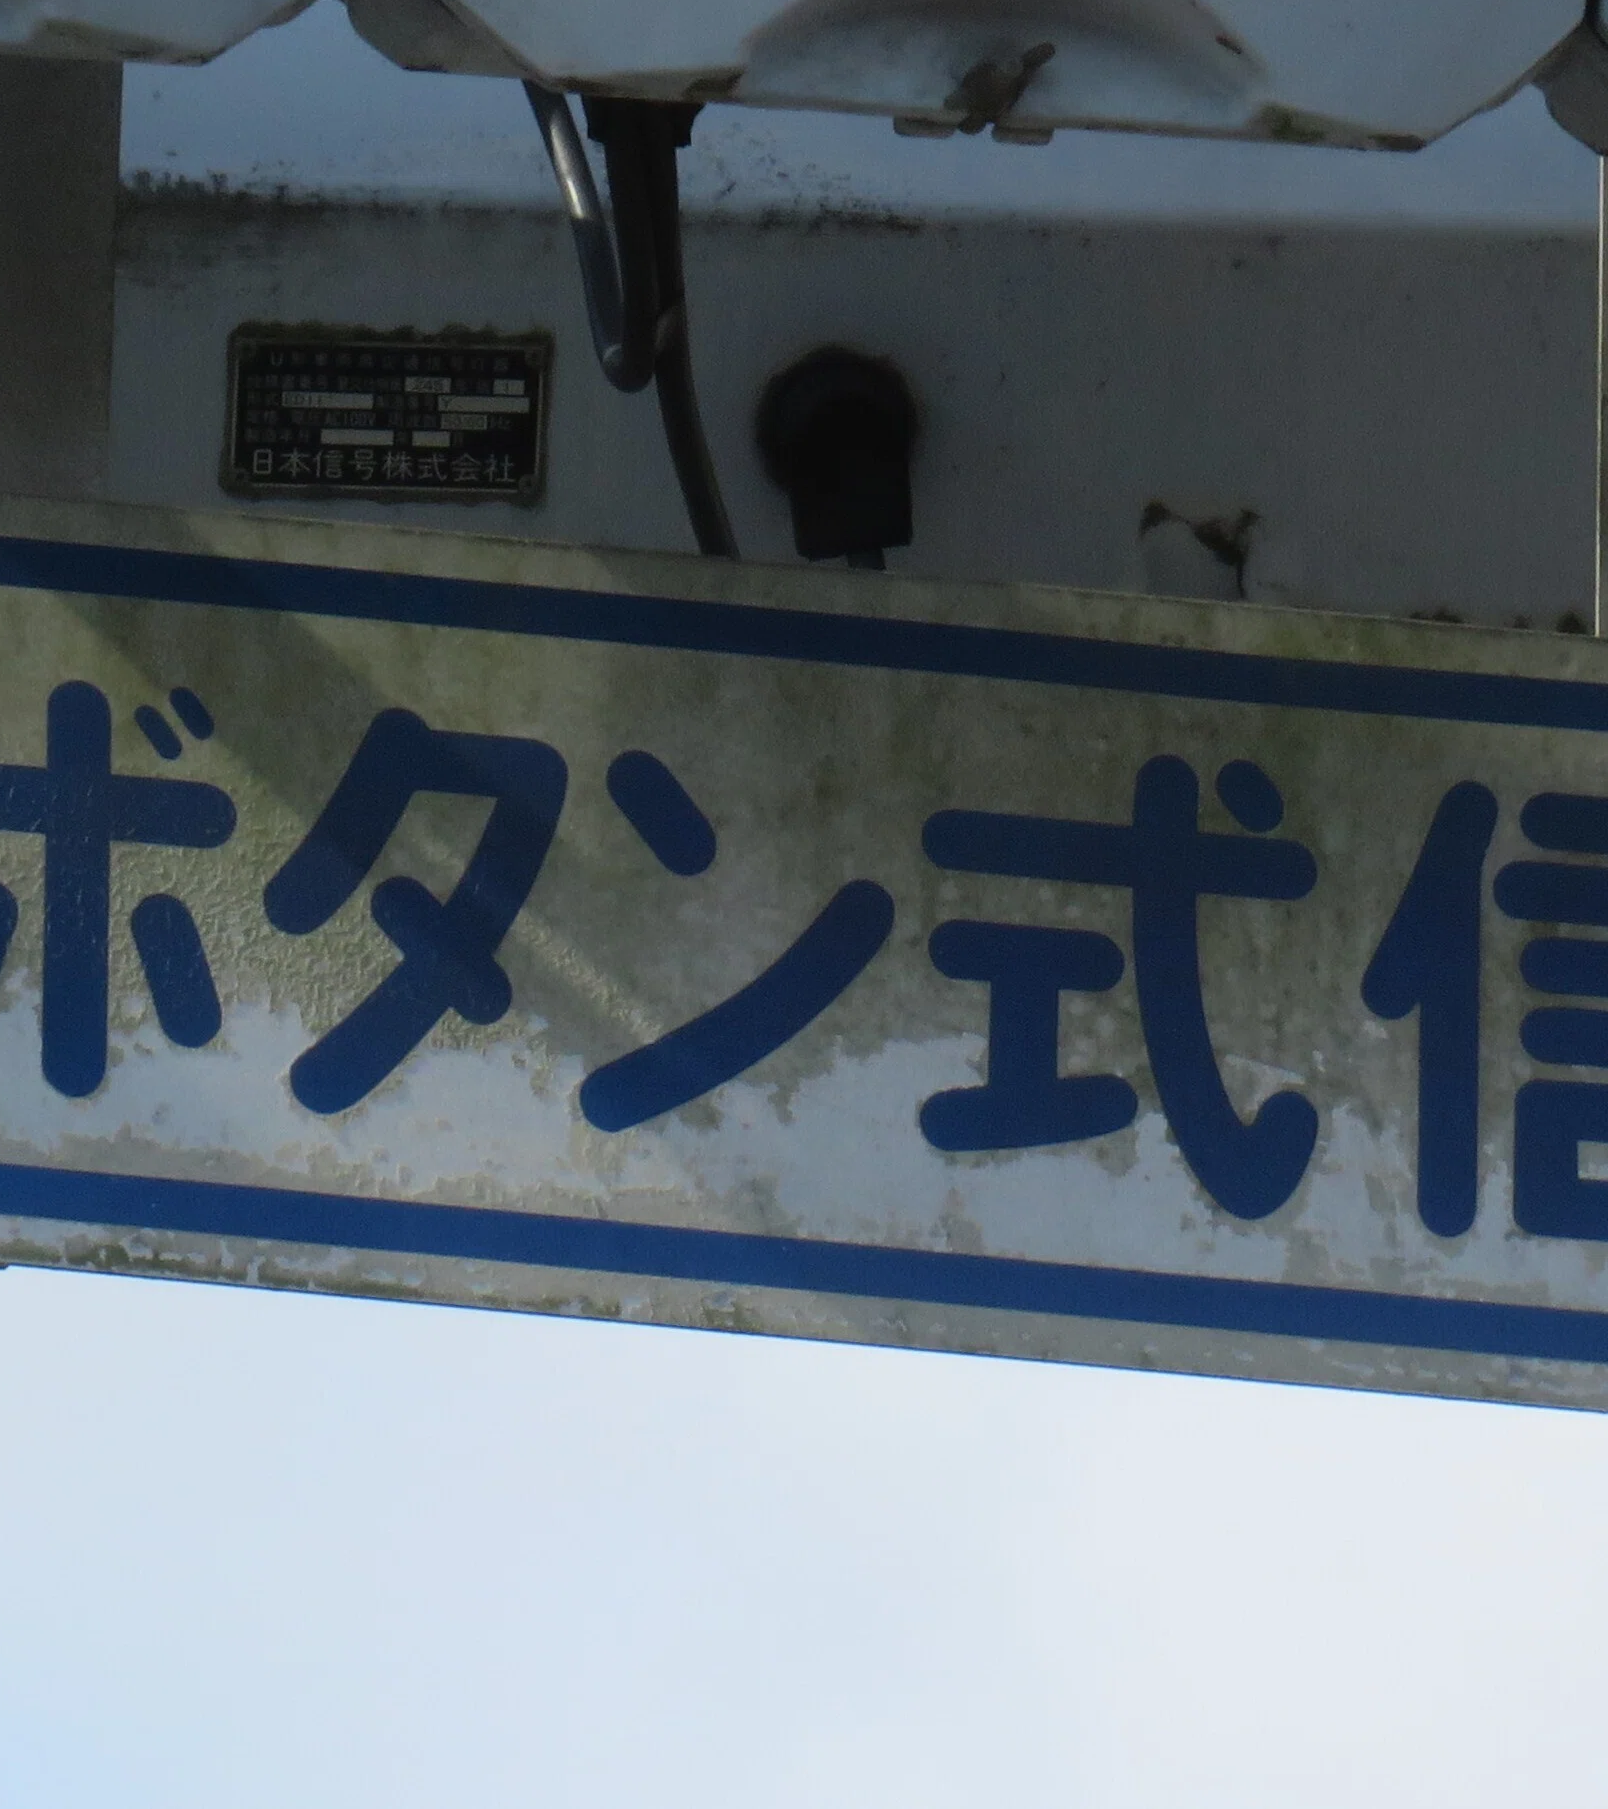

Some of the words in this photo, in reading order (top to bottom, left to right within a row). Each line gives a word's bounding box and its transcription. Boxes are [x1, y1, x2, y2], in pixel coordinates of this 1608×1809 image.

[252, 447, 517, 483] 日本信号株式会社
